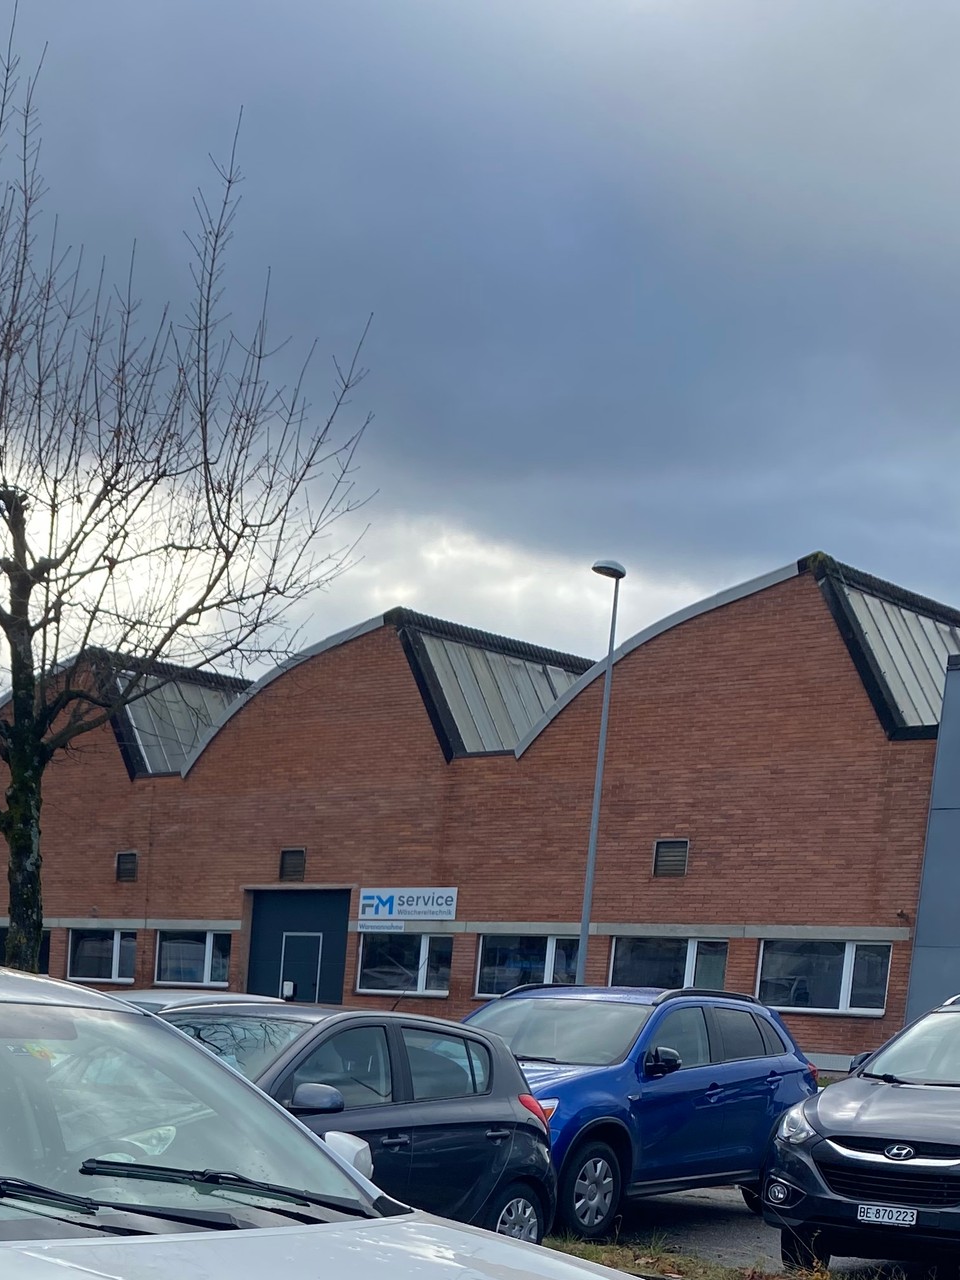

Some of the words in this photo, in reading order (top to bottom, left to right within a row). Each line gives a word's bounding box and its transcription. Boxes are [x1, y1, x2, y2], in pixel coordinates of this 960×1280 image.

[361, 895, 394, 915] FM
[398, 892, 454, 906] service
[859, 1207, 871, 1218] BE
[874, 1208, 893, 1220] 870
[895, 1210, 915, 1222] 223
